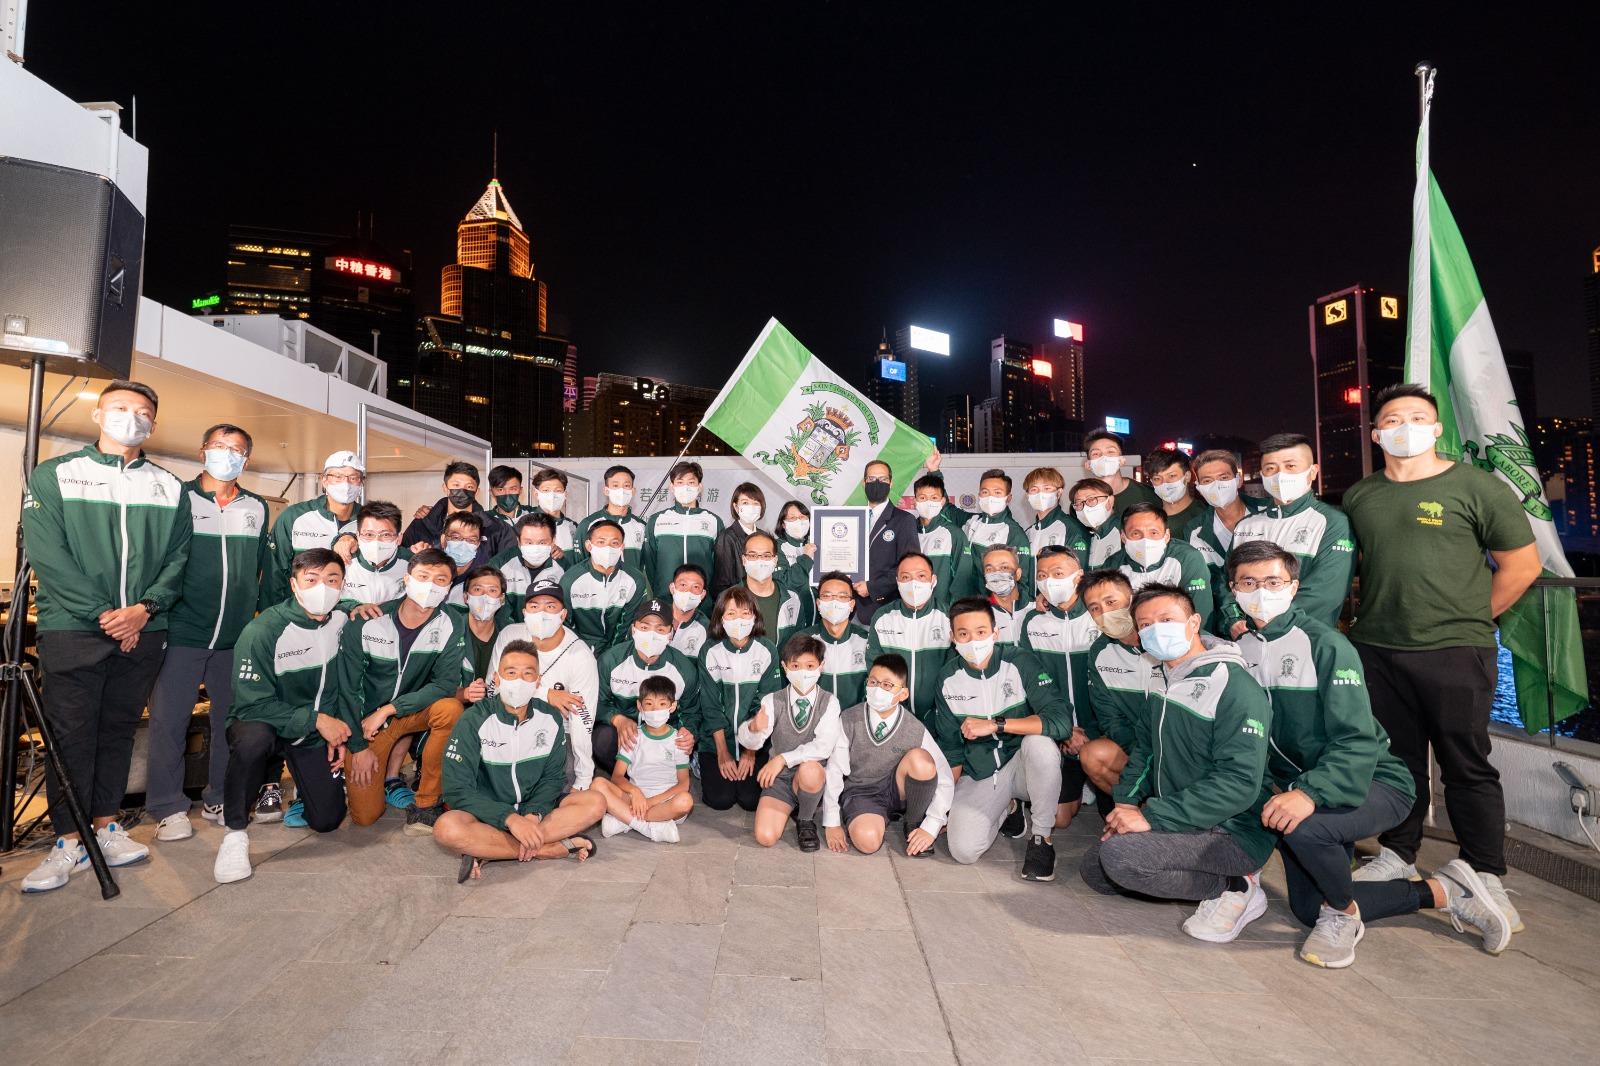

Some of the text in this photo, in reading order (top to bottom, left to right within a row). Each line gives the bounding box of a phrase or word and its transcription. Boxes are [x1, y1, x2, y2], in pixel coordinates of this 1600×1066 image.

[1491, 454, 1532, 489] LABORE
[59, 477, 93, 487] speedo
[651, 600, 661, 611] LA
[362, 634, 386, 645] speedo
[277, 649, 304, 660] speedo
[1097, 665, 1123, 674] speedo
